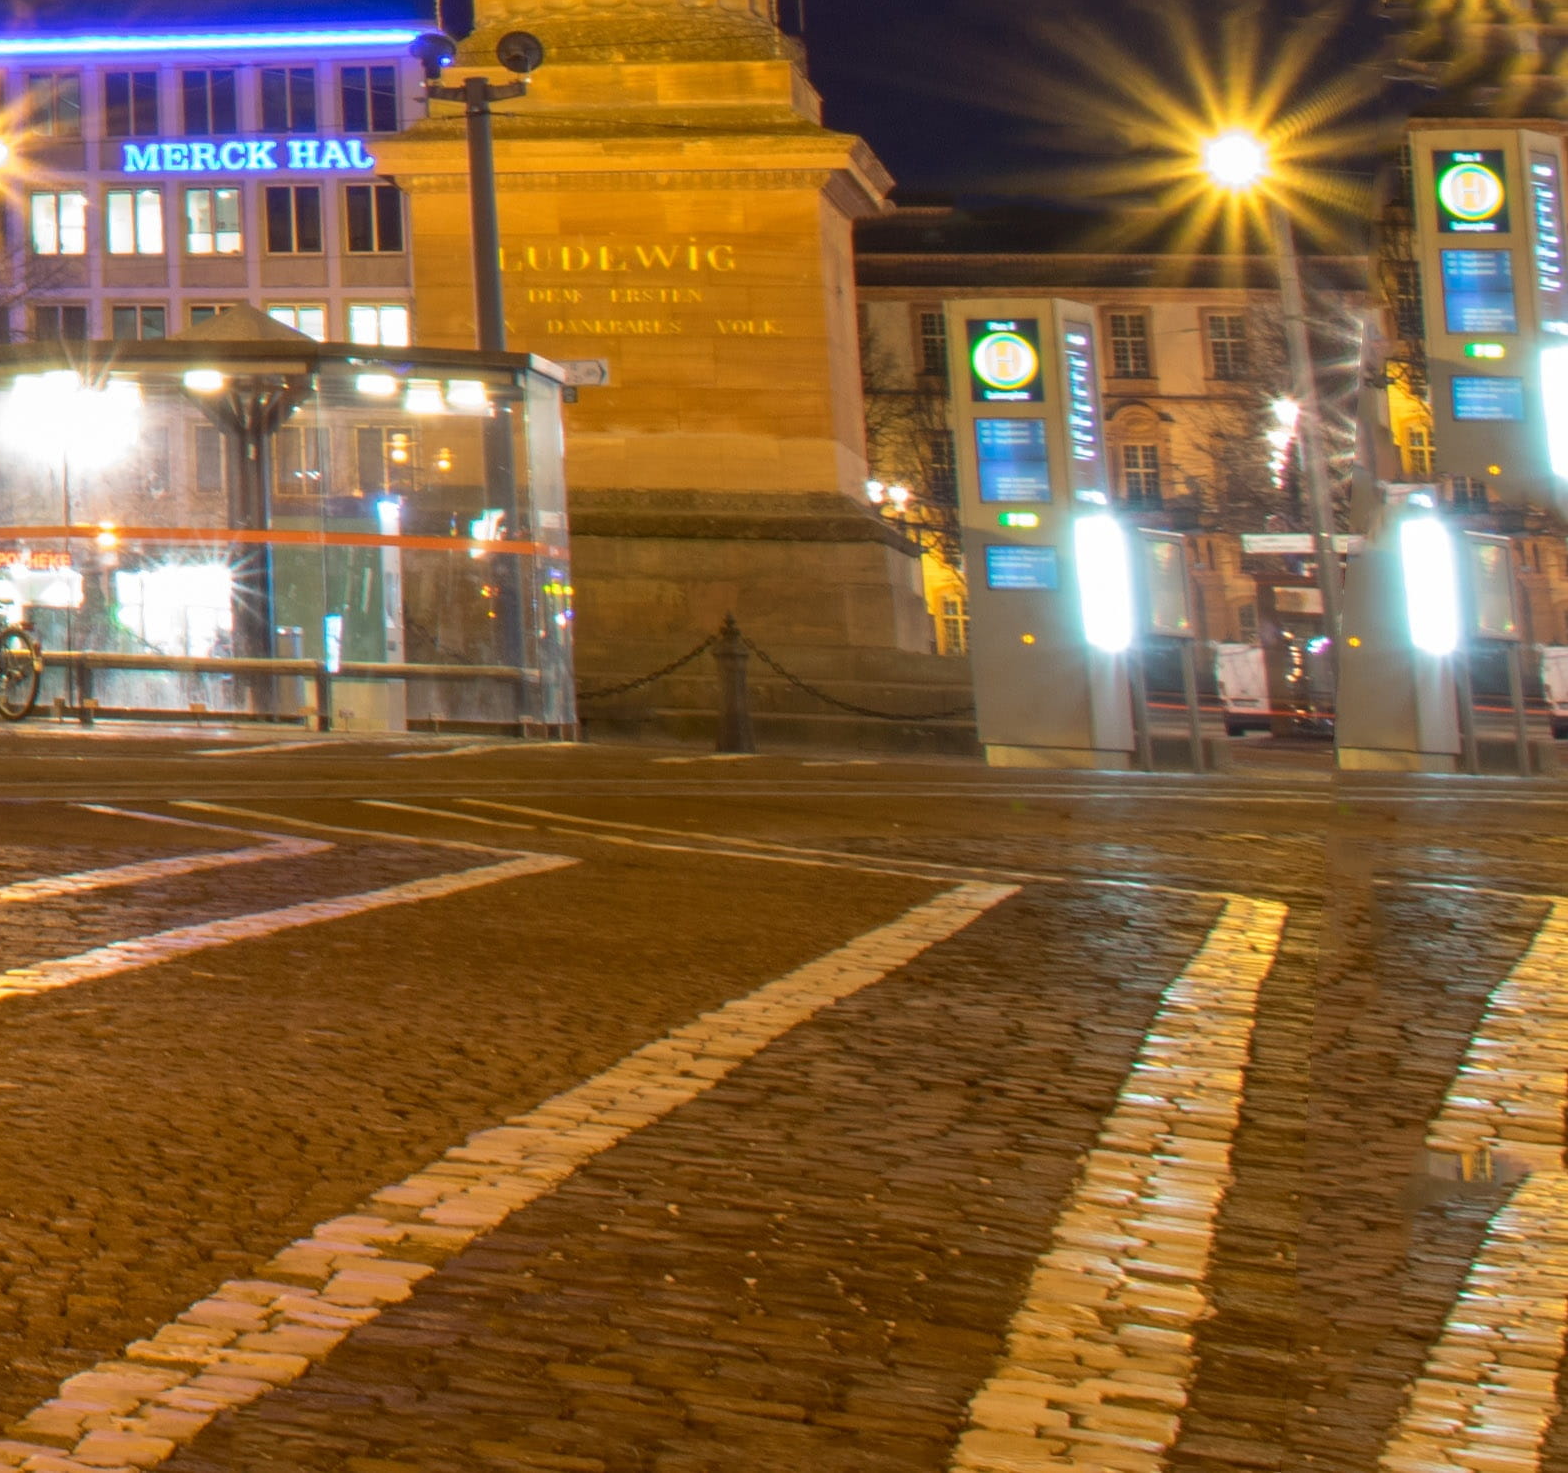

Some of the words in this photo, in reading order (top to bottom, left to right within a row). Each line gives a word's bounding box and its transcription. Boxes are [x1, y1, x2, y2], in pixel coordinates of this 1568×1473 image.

[123, 141, 277, 172] MERCK
[528, 289, 582, 304] DEM
[610, 289, 703, 304] ERSTEN
[547, 319, 681, 335] DANKBARES
